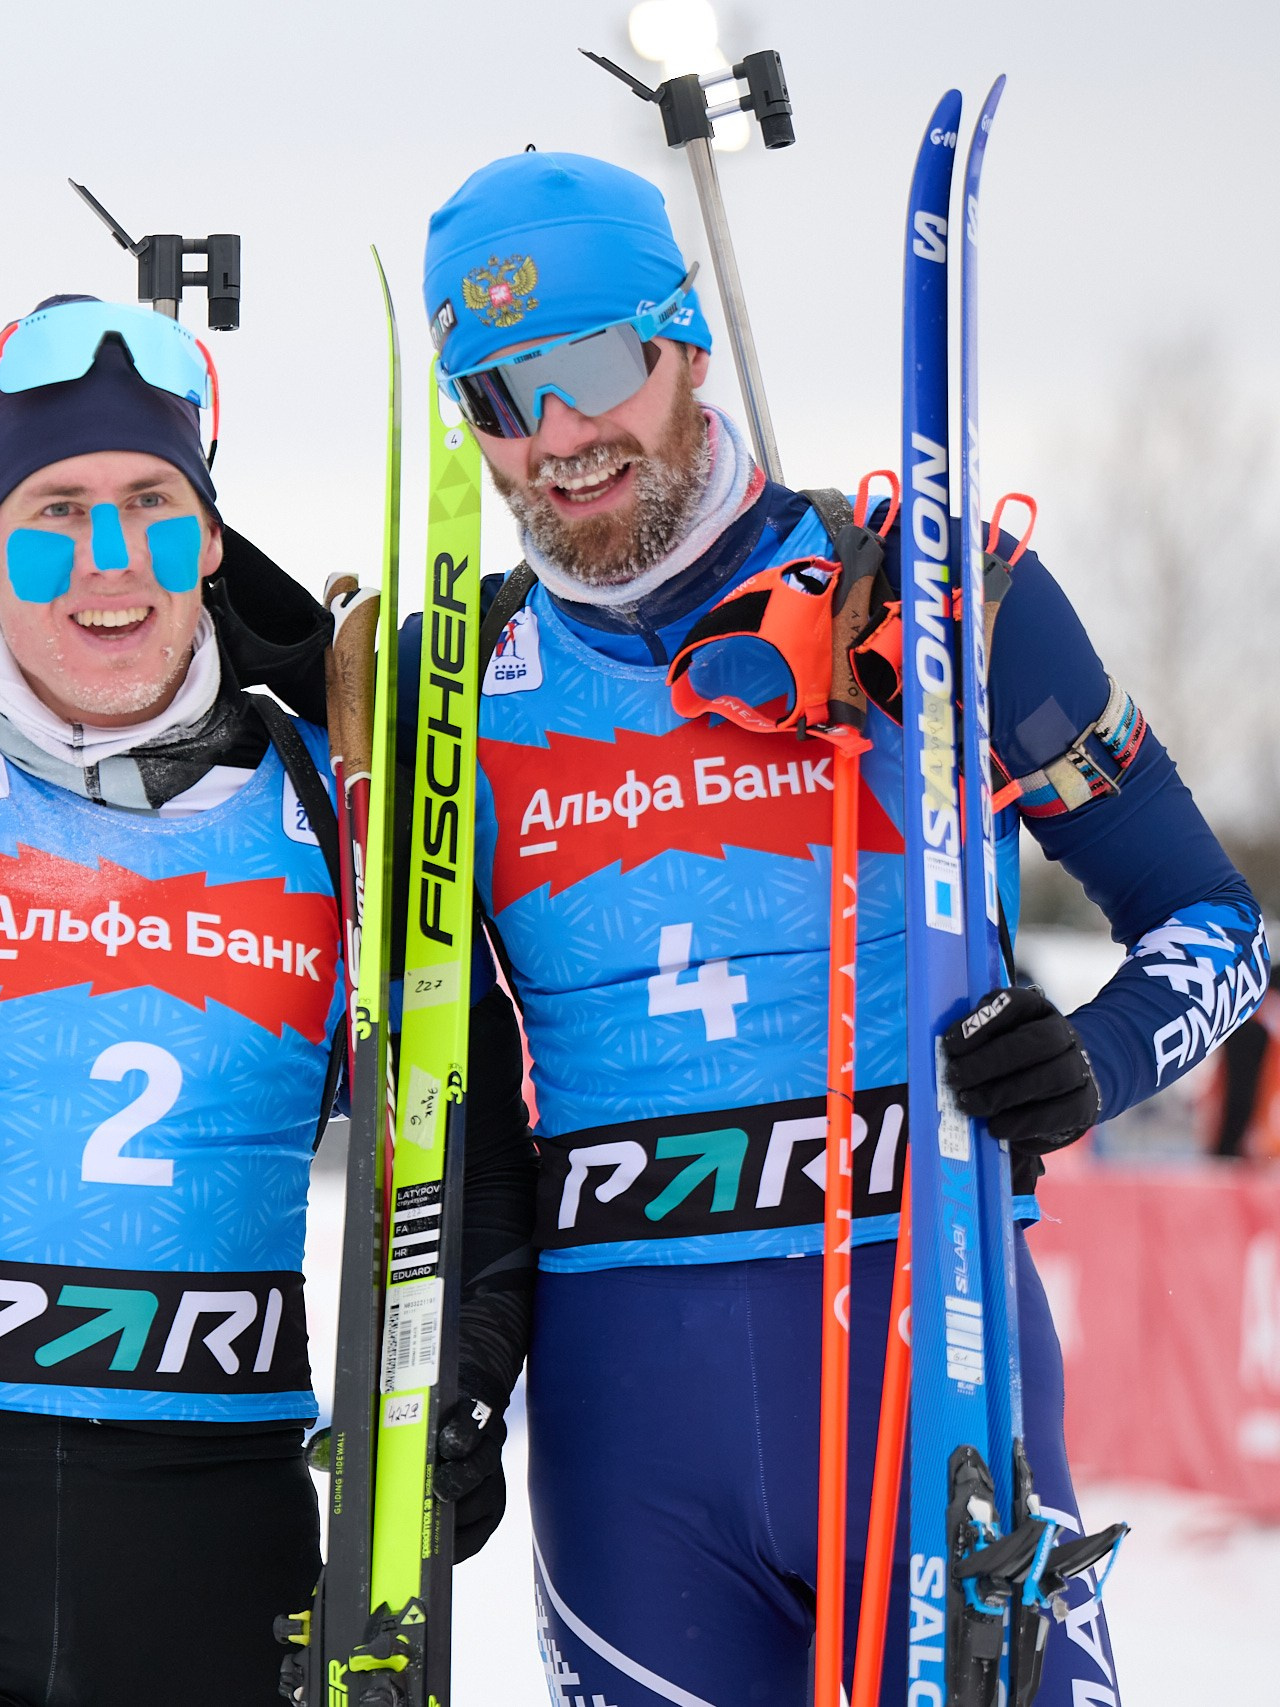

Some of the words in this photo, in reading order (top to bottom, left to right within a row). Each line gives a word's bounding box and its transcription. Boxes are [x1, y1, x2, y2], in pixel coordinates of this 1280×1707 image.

[450, 434, 458, 445] 4
[911, 431, 962, 860] SALOMON
[495, 669, 527, 681] СБР
[419, 551, 469, 947] FISCHER
[520, 769, 684, 846] Альфа
[693, 754, 836, 807] Банк
[187, 911, 323, 983] Банк
[414, 979, 443, 993] 227
[647, 922, 748, 1042] 4
[962, 992, 1011, 1038] KV+
[80, 1040, 185, 1188] 2
[557, 1102, 906, 1230] PARI
[397, 1184, 441, 1201] LATYPOV
[394, 1247, 408, 1258] HR
[395, 1225, 409, 1235] FA
[392, 1266, 432, 1281] EDUARD
[336, 1431, 346, 1476] SIDEWALL
[333, 1477, 343, 1515] GLIDING
